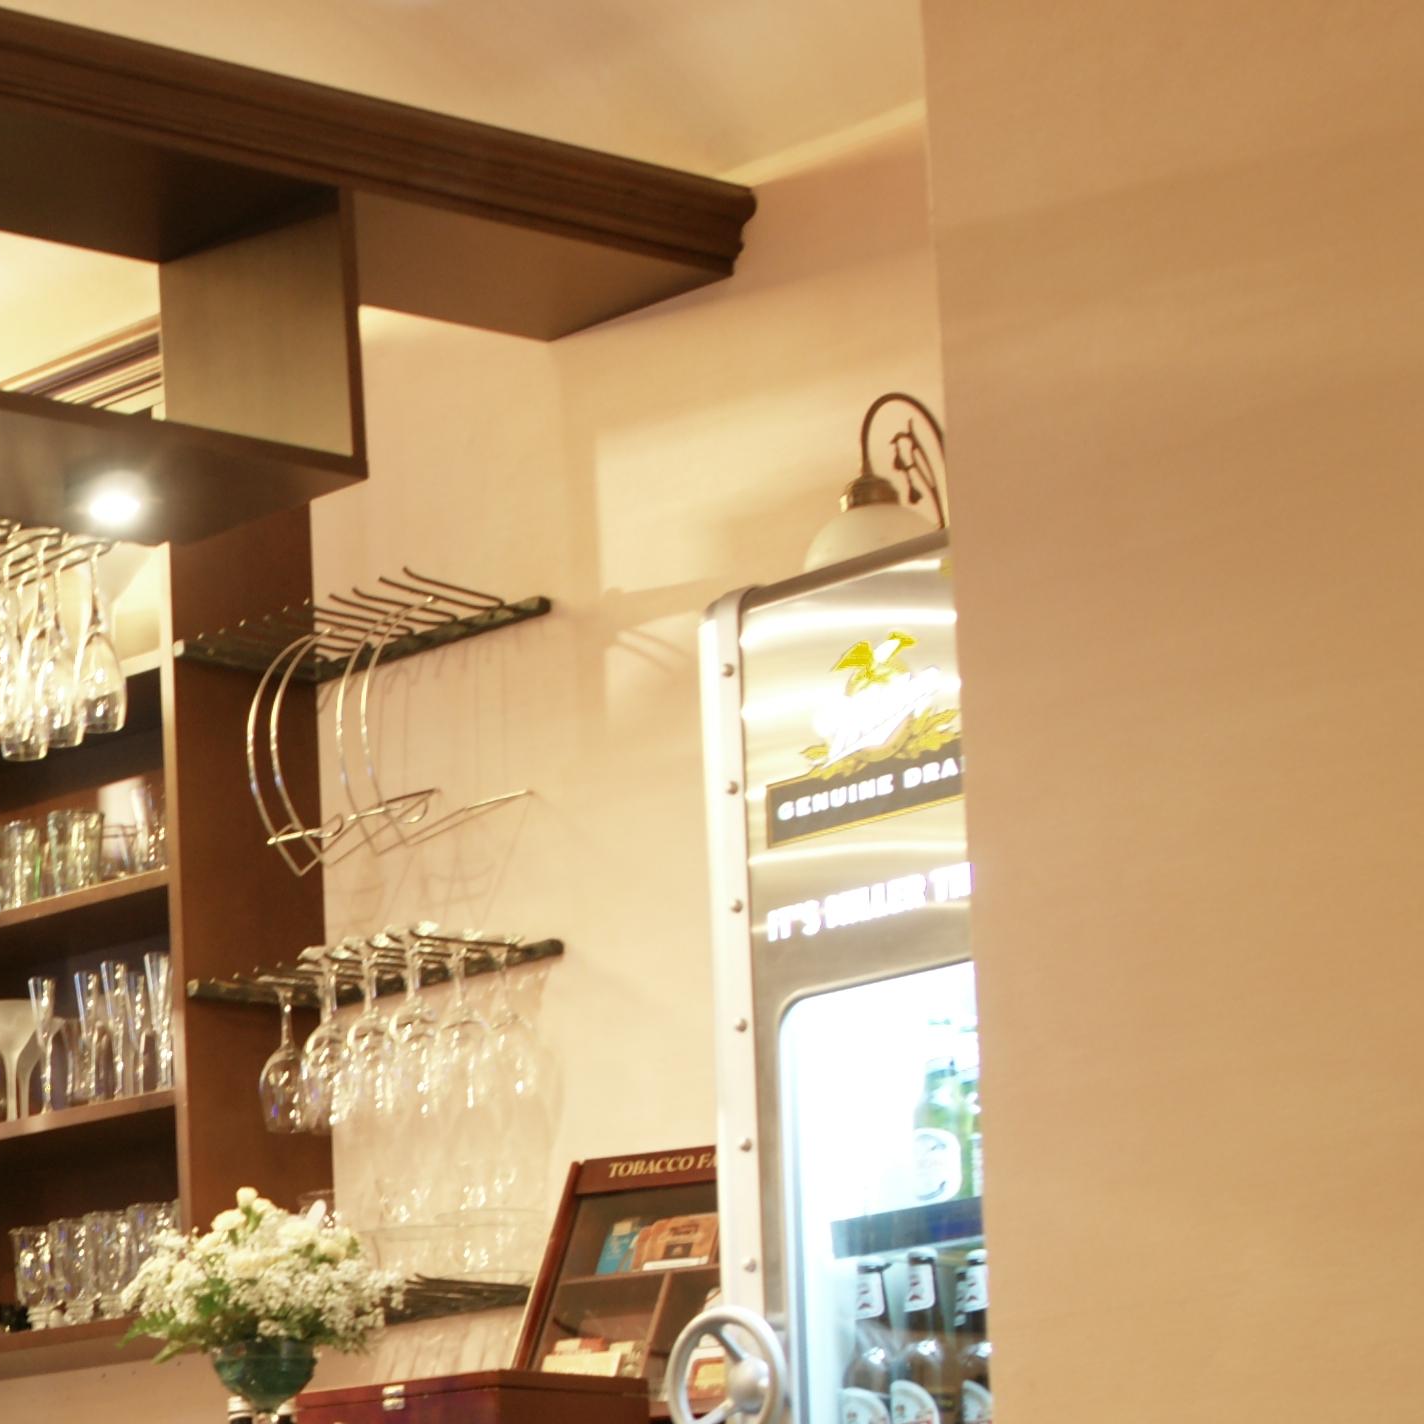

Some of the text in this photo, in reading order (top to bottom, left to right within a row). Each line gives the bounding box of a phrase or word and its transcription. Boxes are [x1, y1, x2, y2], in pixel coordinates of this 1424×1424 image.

[777, 757, 966, 821] GENUINE DRA
[608, 1155, 695, 1178] TOBACCO
